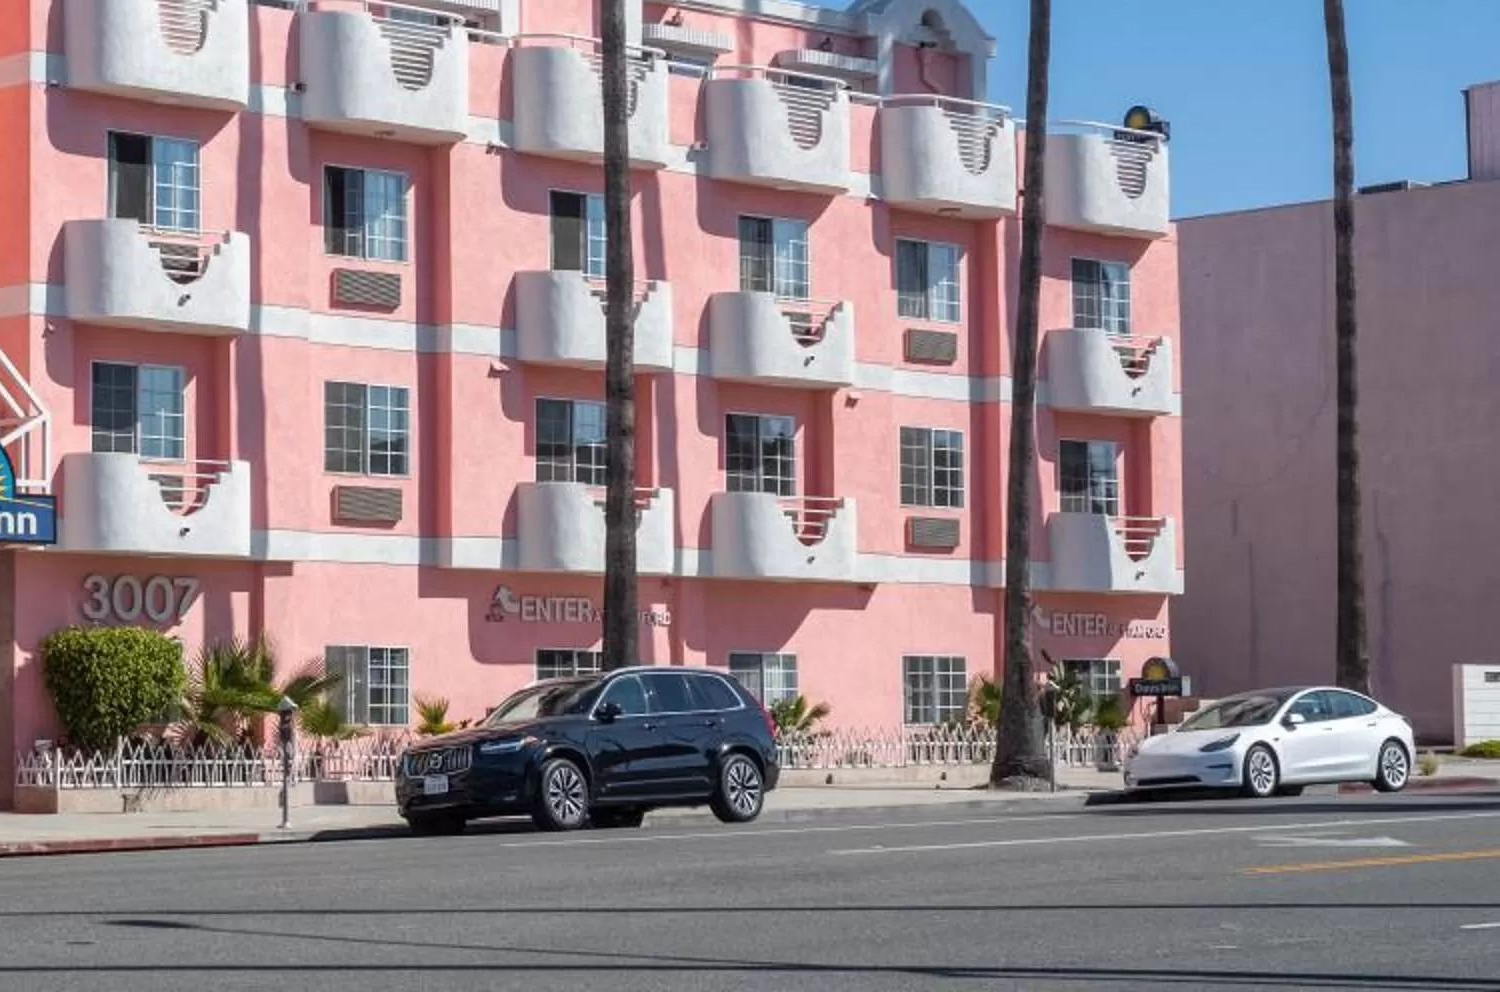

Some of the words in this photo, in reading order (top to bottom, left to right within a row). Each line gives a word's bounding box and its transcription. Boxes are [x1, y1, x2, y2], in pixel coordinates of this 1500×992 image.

[83, 575, 199, 622] 3007
[521, 596, 592, 622] ENTER
[1053, 613, 1107, 635] ENTER
